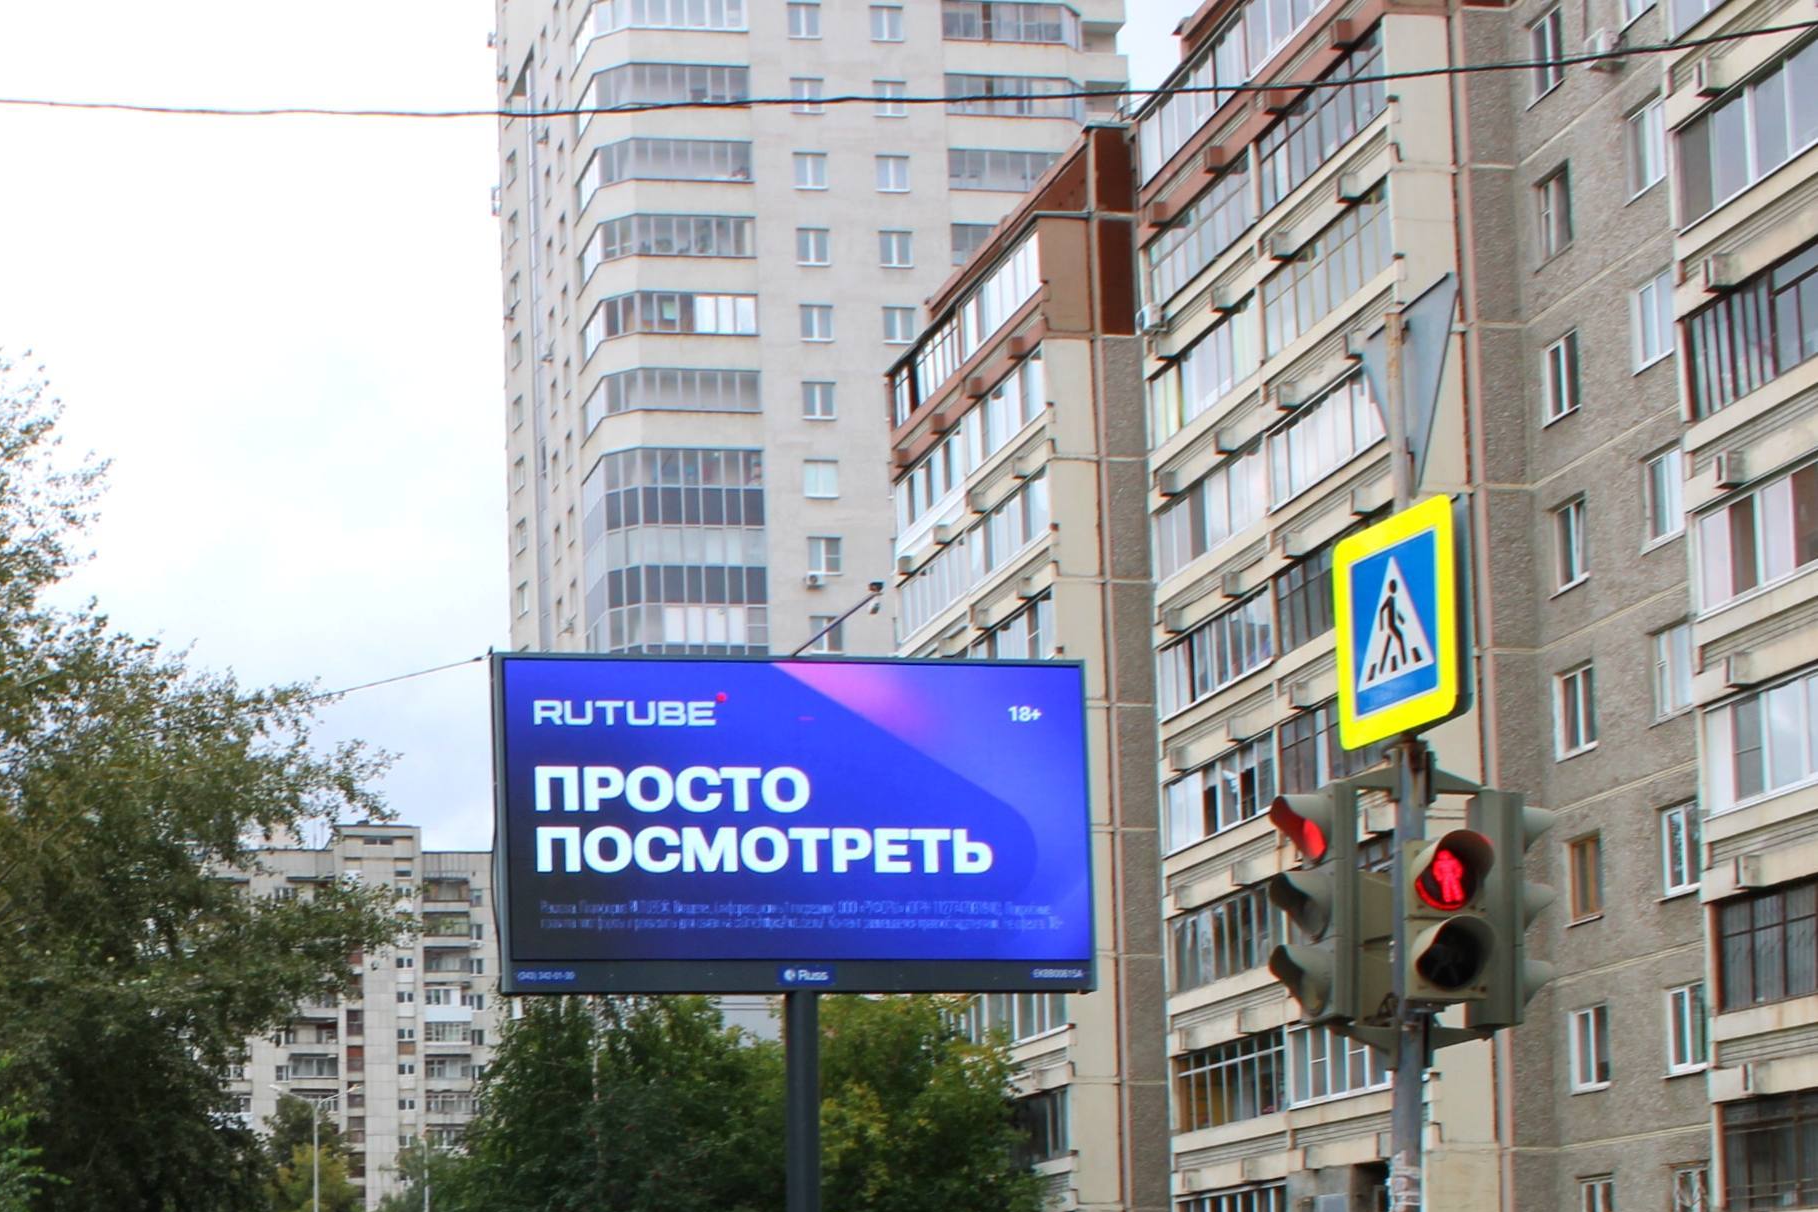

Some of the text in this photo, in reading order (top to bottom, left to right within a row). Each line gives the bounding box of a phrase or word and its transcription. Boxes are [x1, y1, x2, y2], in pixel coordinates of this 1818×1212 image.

[533, 699, 717, 727] RUTUBE
[1008, 705, 1042, 722] 18+
[533, 765, 811, 813] ПРОСТО
[535, 826, 994, 874] ПОСМОТРЕТЬ
[797, 969, 829, 981] Russ
